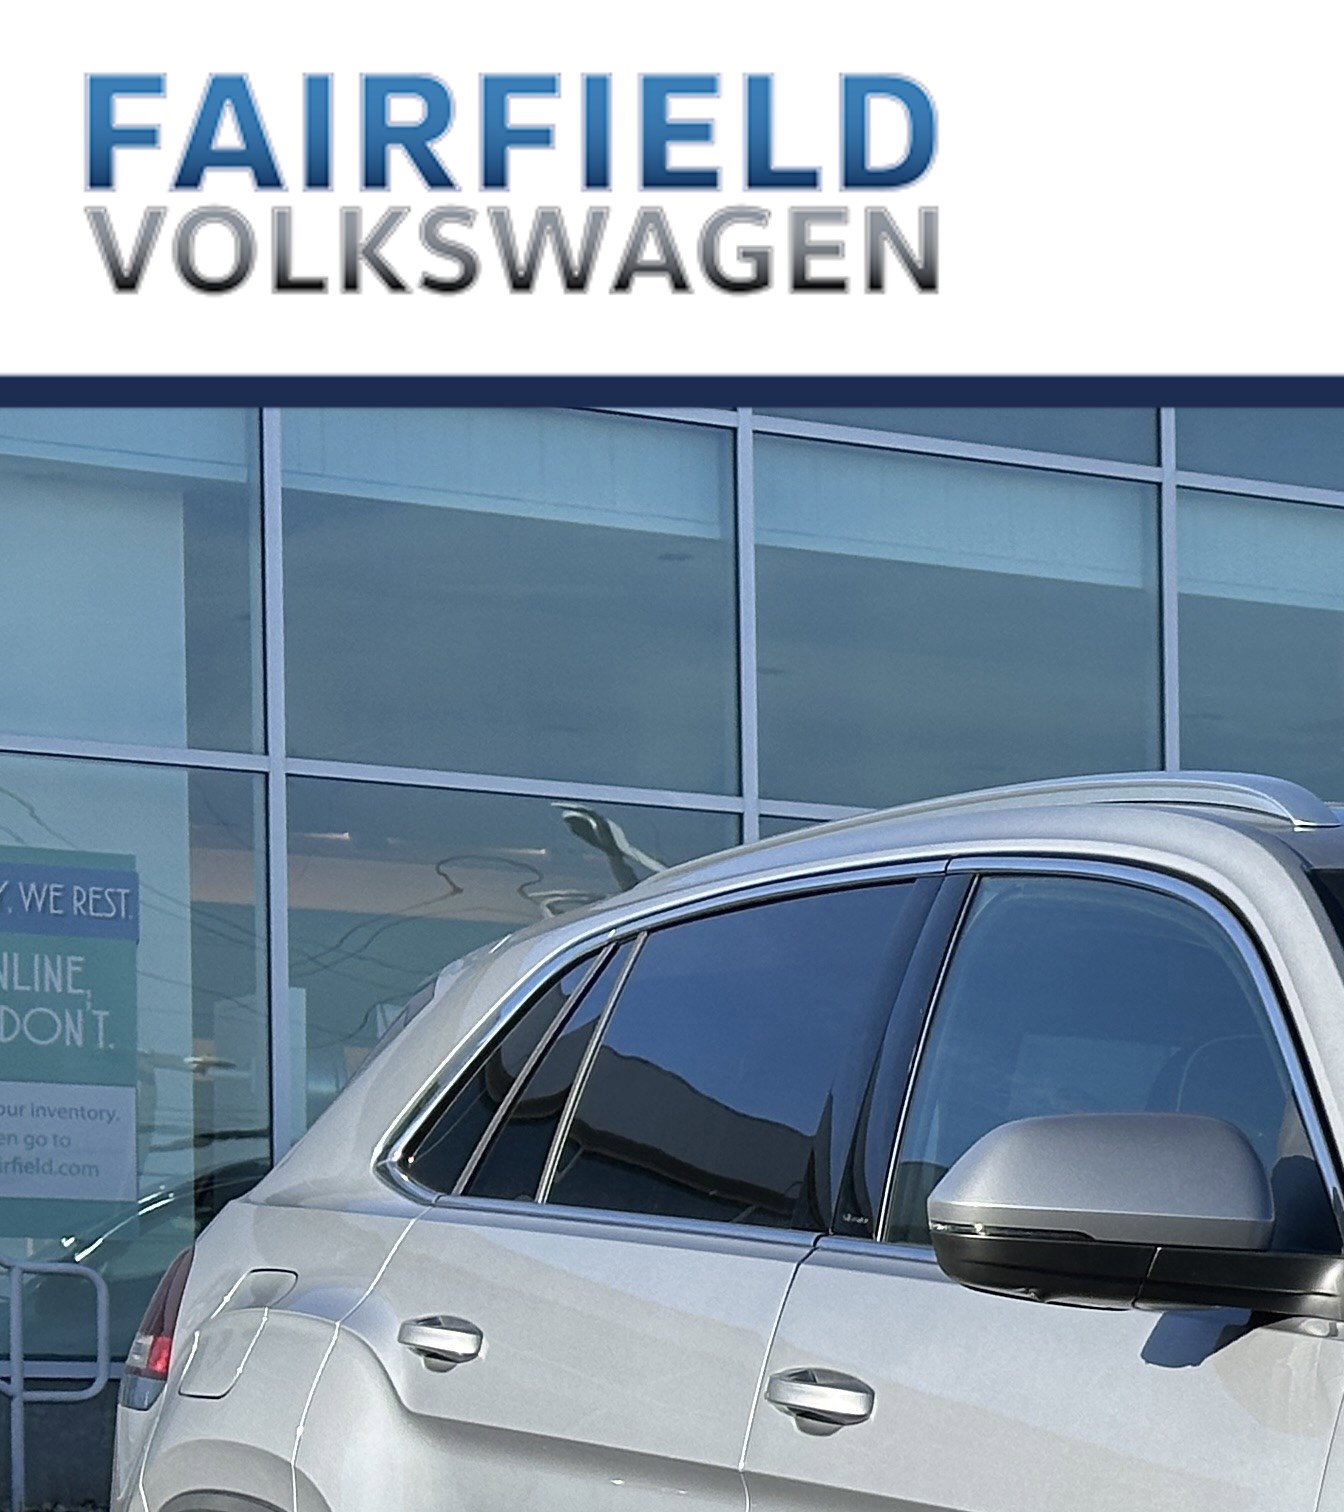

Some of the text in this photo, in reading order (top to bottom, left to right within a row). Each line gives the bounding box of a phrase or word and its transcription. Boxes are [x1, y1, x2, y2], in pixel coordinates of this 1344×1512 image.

[18, 880, 65, 915] WE
[72, 884, 134, 921] REST.
[30, 1101, 121, 1125] inventory.
[22, 1132, 49, 1151] go
[52, 1133, 72, 1149] to
